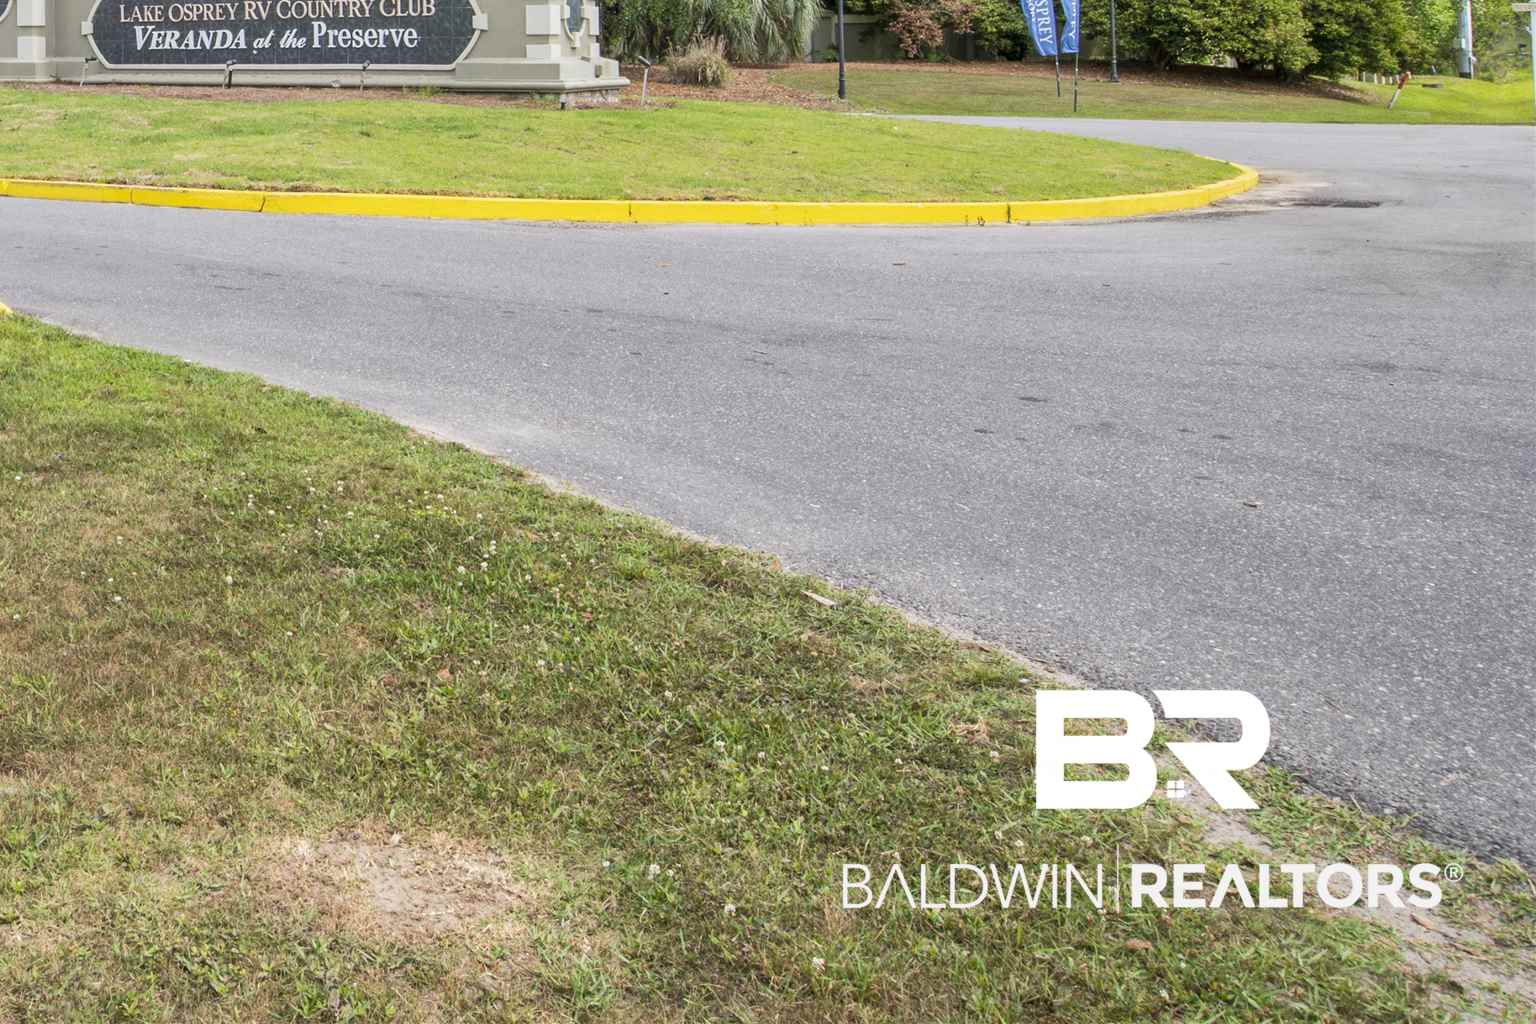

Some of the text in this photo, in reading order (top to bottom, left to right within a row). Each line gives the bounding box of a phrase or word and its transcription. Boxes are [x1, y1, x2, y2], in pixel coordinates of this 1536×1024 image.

[120, 5, 164, 23] LAKE
[168, 3, 239, 23] OSPREY
[244, 0, 272, 20] RV
[276, 0, 374, 19] COUNTRY
[134, 21, 418, 52] VERANDA at the Preserve
